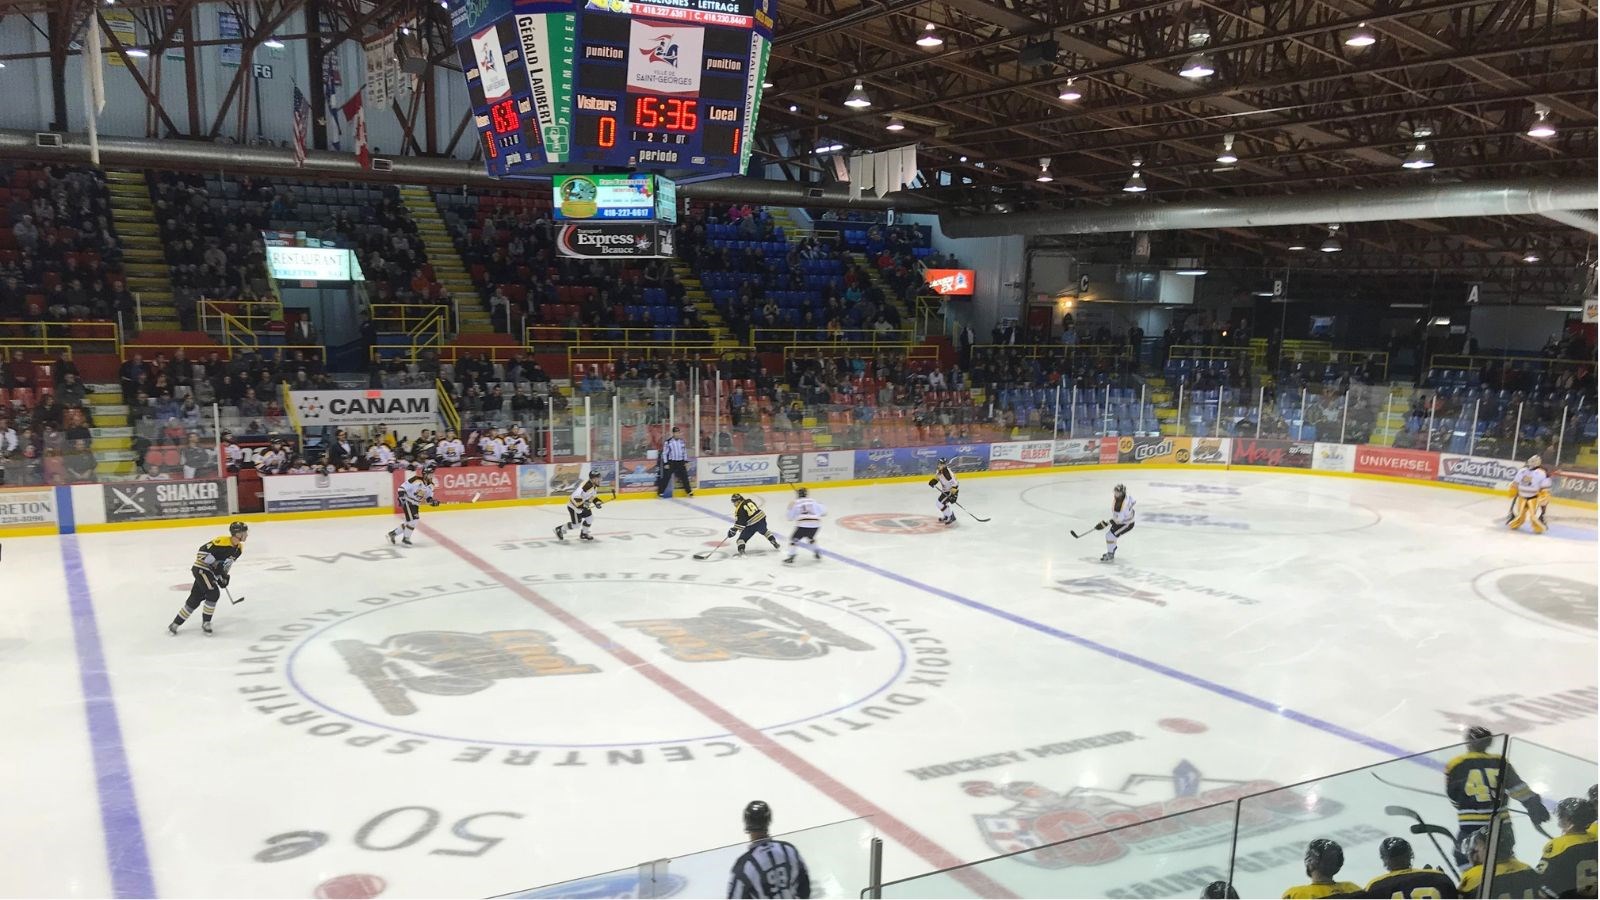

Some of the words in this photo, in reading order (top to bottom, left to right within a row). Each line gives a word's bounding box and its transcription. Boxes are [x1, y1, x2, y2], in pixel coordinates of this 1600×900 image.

[698, 1, 739, 12] LETTRAGE
[585, 46, 624, 59] punition
[254, 65, 272, 78] FG
[518, 16, 539, 65] GÉRALD
[530, 67, 553, 125] LAMBERT
[558, 14, 575, 125] PHARMACIEN
[707, 58, 742, 71] punition
[636, 74, 692, 86] SAINT-GEORGES
[577, 95, 617, 111] Visiteurs
[636, 97, 697, 130] 15:36
[710, 106, 738, 121] Local
[599, 117, 617, 147] 0
[732, 128, 740, 154] 1
[639, 149, 678, 163] periode
[577, 234, 635, 247] Express
[602, 246, 634, 254] Beauce
[273, 253, 342, 265] RESTAURANT
[1273, 280, 1283, 296] B
[1468, 285, 1479, 302] A
[329, 398, 430, 414] CANAM
[727, 461, 769, 472] VASCO
[1360, 455, 1432, 472] UNIVERSEL
[443, 472, 512, 489] GARAGA
[156, 482, 219, 502] SHAKER
[885, 618, 952, 688] LACROIX
[238, 685, 428, 754] SPORTIF
[773, 693, 927, 742] DUTIL
[452, 741, 741, 768] CENTRE
[905, 751, 1027, 781] HOCKEY
